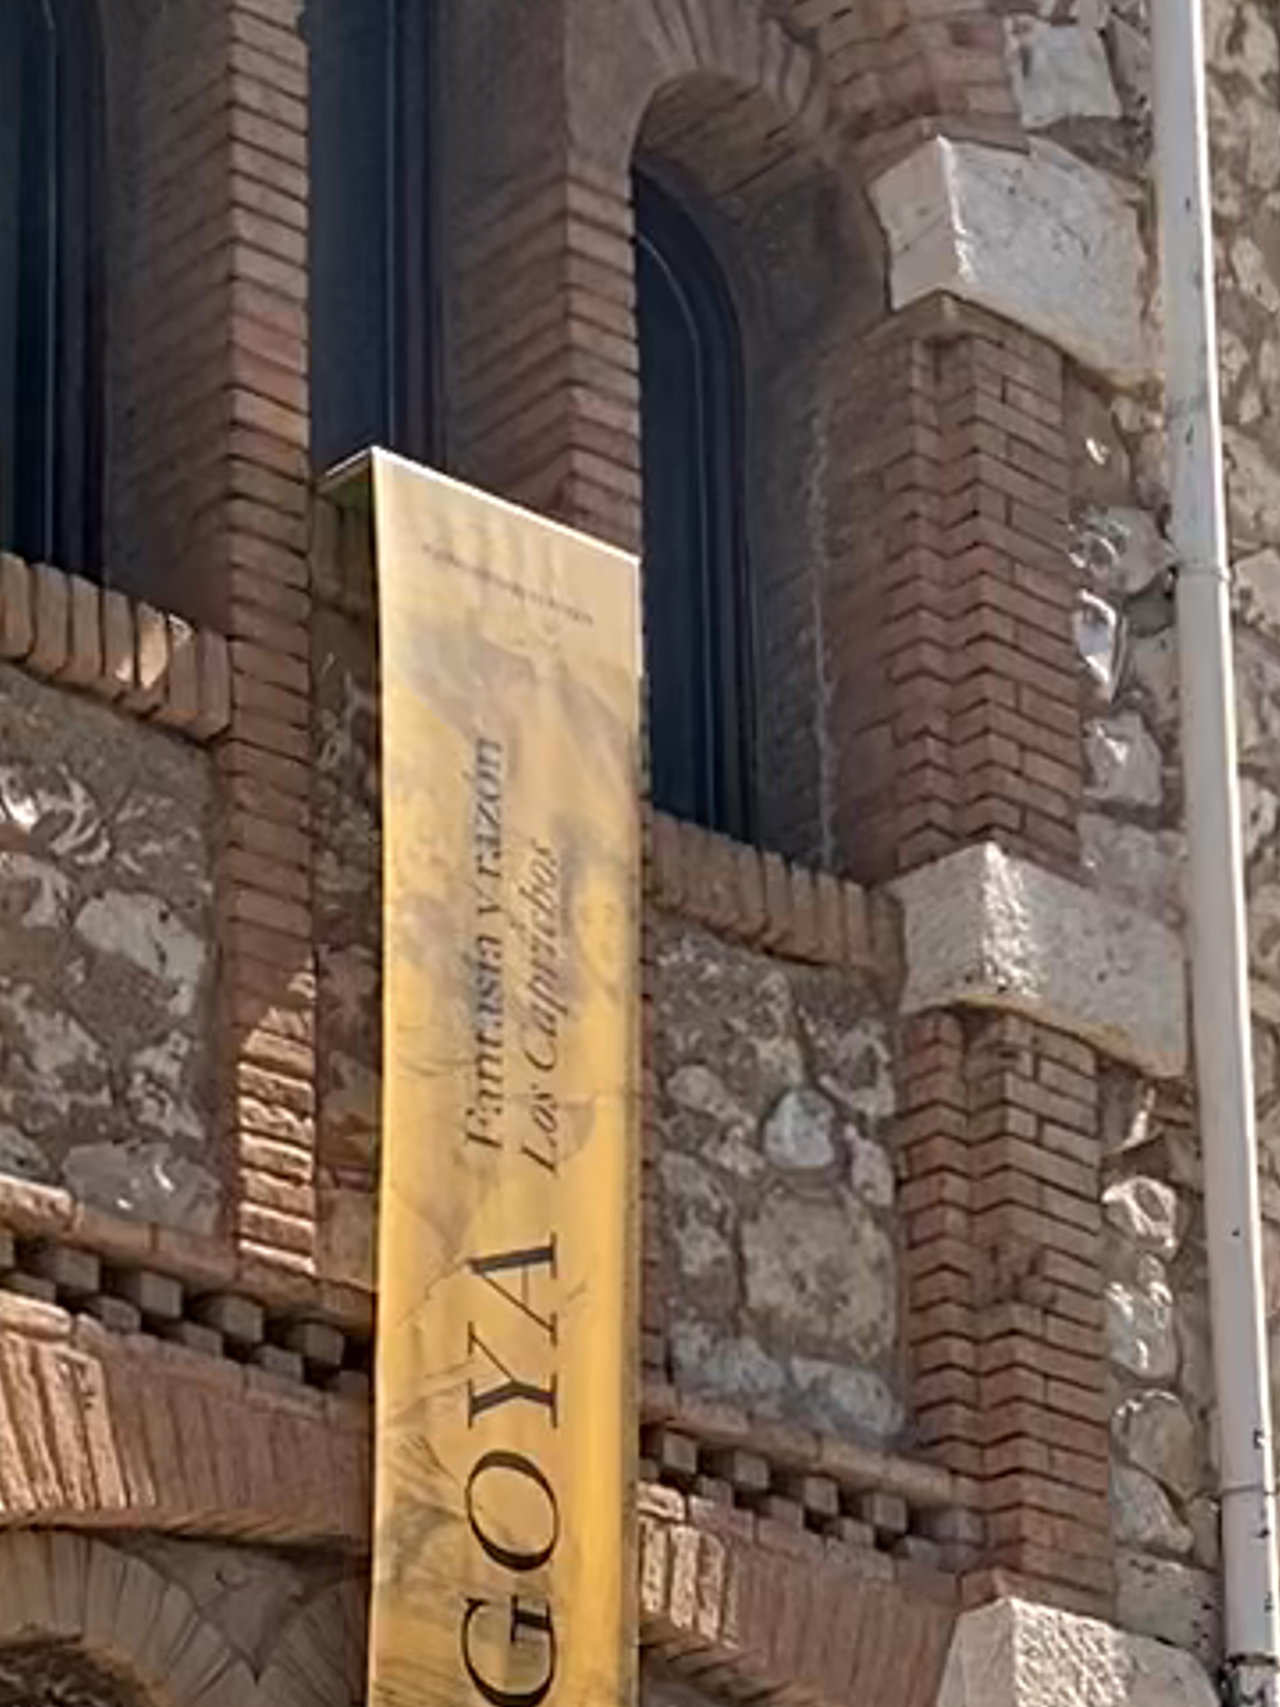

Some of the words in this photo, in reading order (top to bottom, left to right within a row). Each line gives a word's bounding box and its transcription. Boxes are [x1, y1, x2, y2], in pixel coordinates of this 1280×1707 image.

[461, 737, 503, 878] razón
[462, 936, 504, 1151] Fantasía
[518, 839, 568, 1071] Caprichos
[520, 1085, 559, 1177] Los
